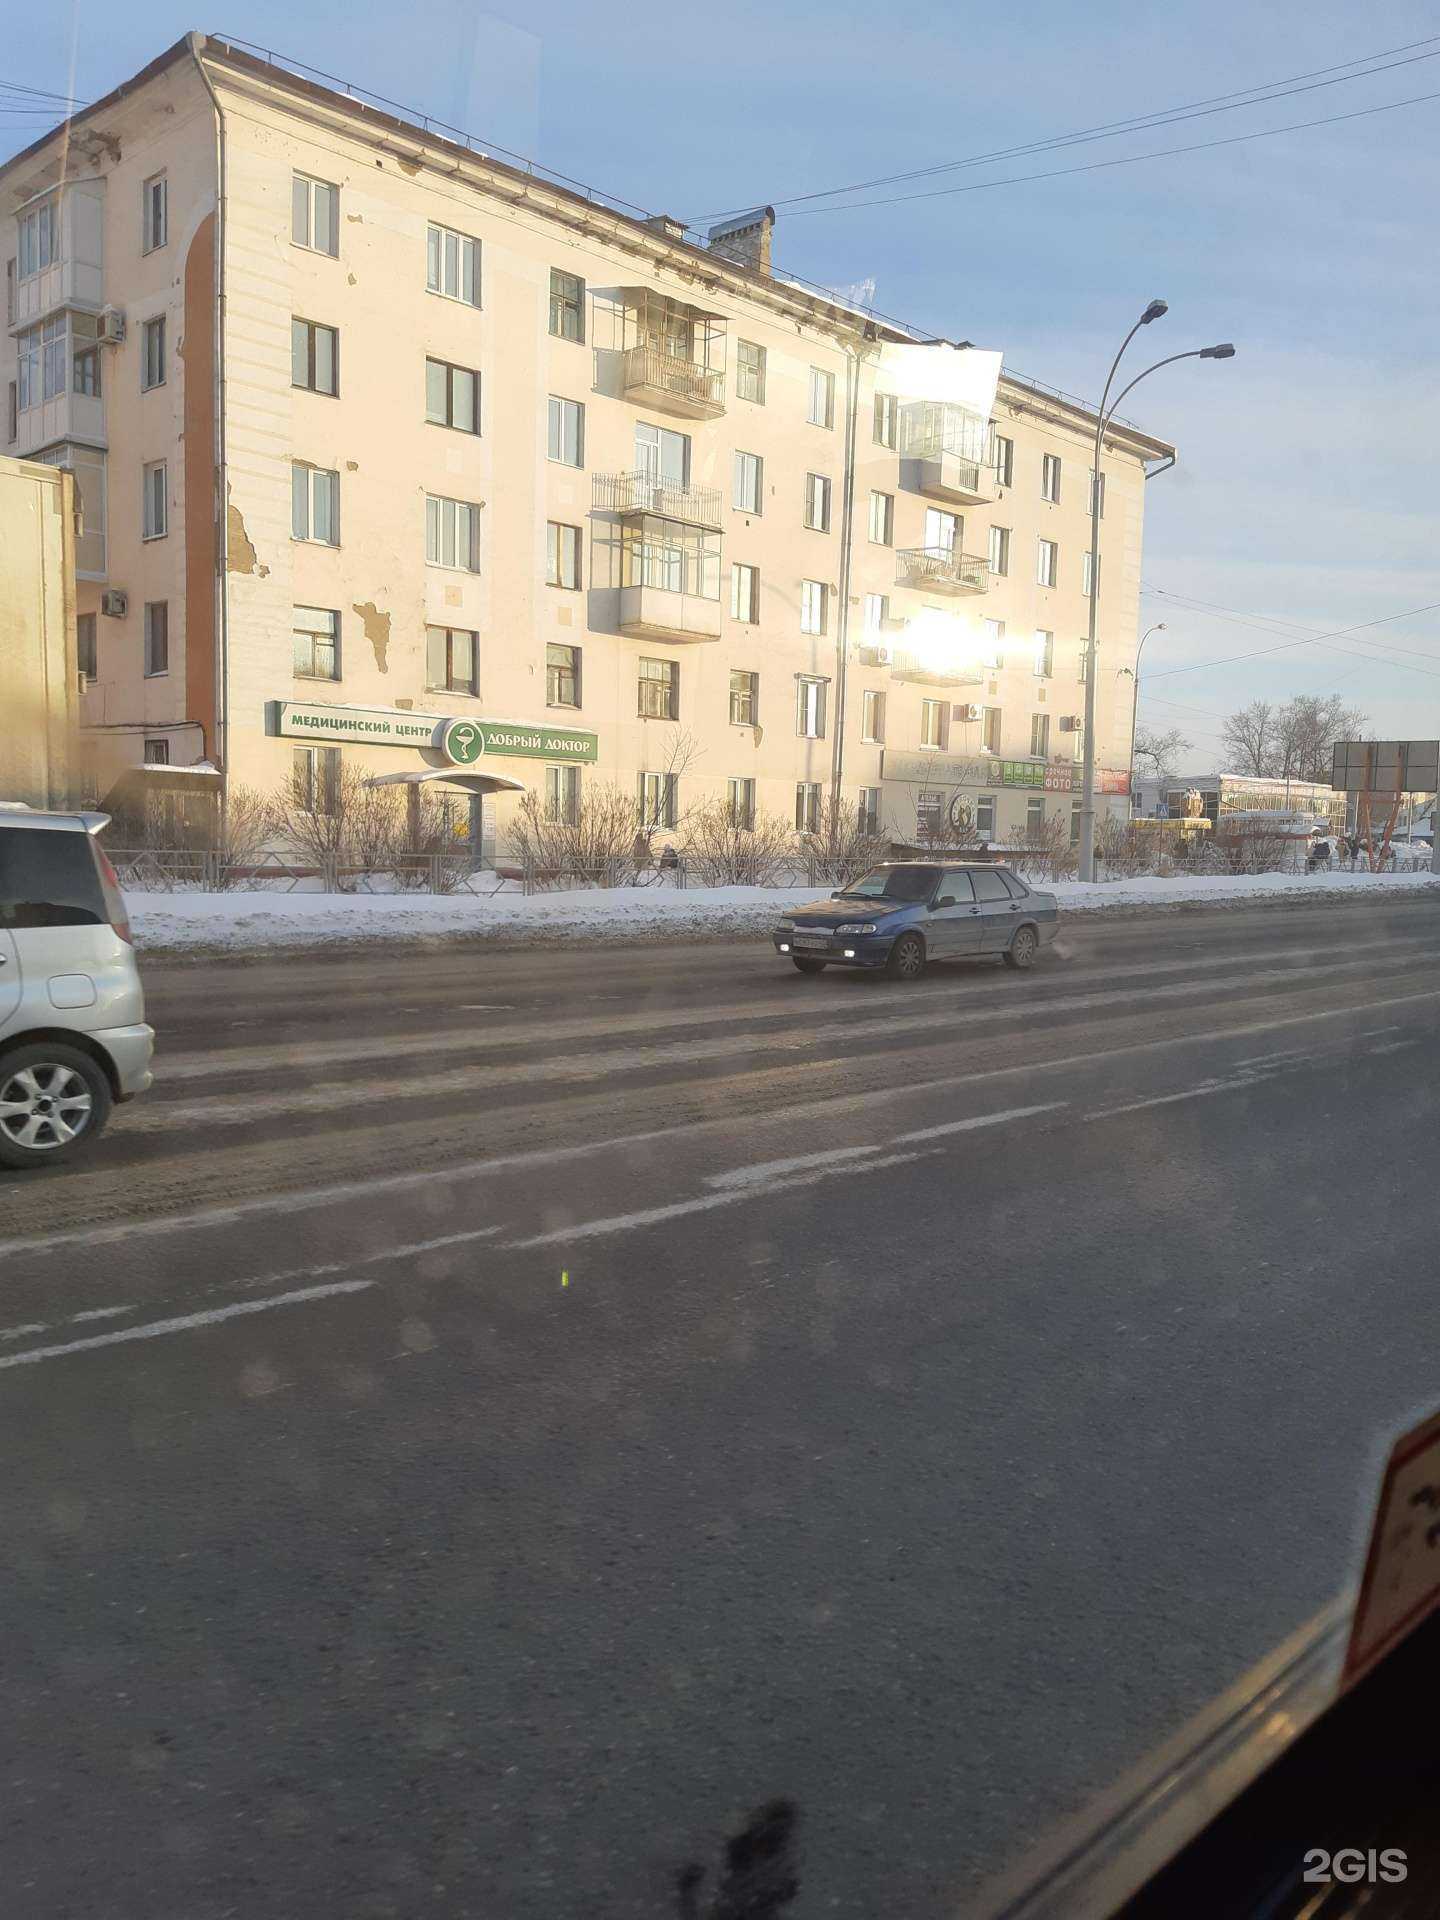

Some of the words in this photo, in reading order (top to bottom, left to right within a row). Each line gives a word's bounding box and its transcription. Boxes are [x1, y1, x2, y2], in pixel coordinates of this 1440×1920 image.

[291, 714, 391, 734] МЕДИЦИНСКИЙ
[395, 725, 432, 736] ЦЕНТР
[486, 733, 541, 749] ДОБРЫЙ
[545, 738, 590, 752] ДОКТОР
[1045, 778, 1071, 790] ФОТО
